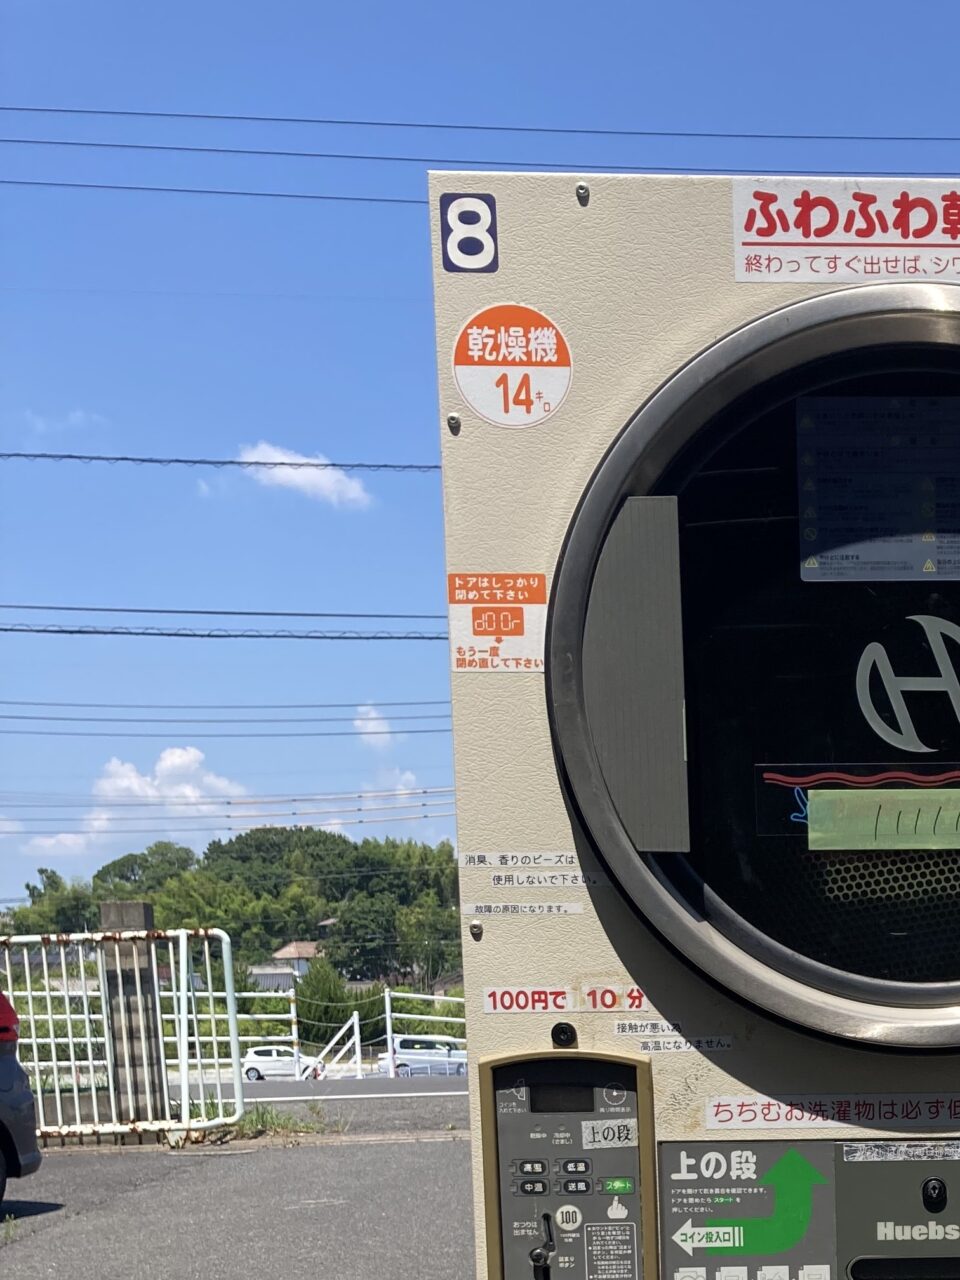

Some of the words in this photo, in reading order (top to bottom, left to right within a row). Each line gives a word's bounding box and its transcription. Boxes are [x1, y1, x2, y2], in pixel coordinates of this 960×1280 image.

[446, 197, 496, 269] 8
[467, 326, 558, 363] 乾燥機
[495, 373, 534, 415] 14
[455, 589, 529, 600] 閉めて下さい
[456, 646, 500, 657] もう一度
[456, 657, 544, 669] 閉め直して下さい
[465, 854, 576, 866] 消臭、香りのビーズは
[492, 874, 598, 887] 使用しないで下さい。
[474, 904, 569, 914] 故障の原因になります。
[488, 989, 567, 1010] 100円で
[587, 989, 617, 1009] 10
[626, 988, 645, 1009] 分
[640, 1039, 731, 1052] 高温になりません。
[588, 1125, 631, 1144] 上の段
[670, 1150, 758, 1180] 上の段
[560, 1210, 577, 1224] 100
[680, 1231, 732, 1244] コイン投入口
